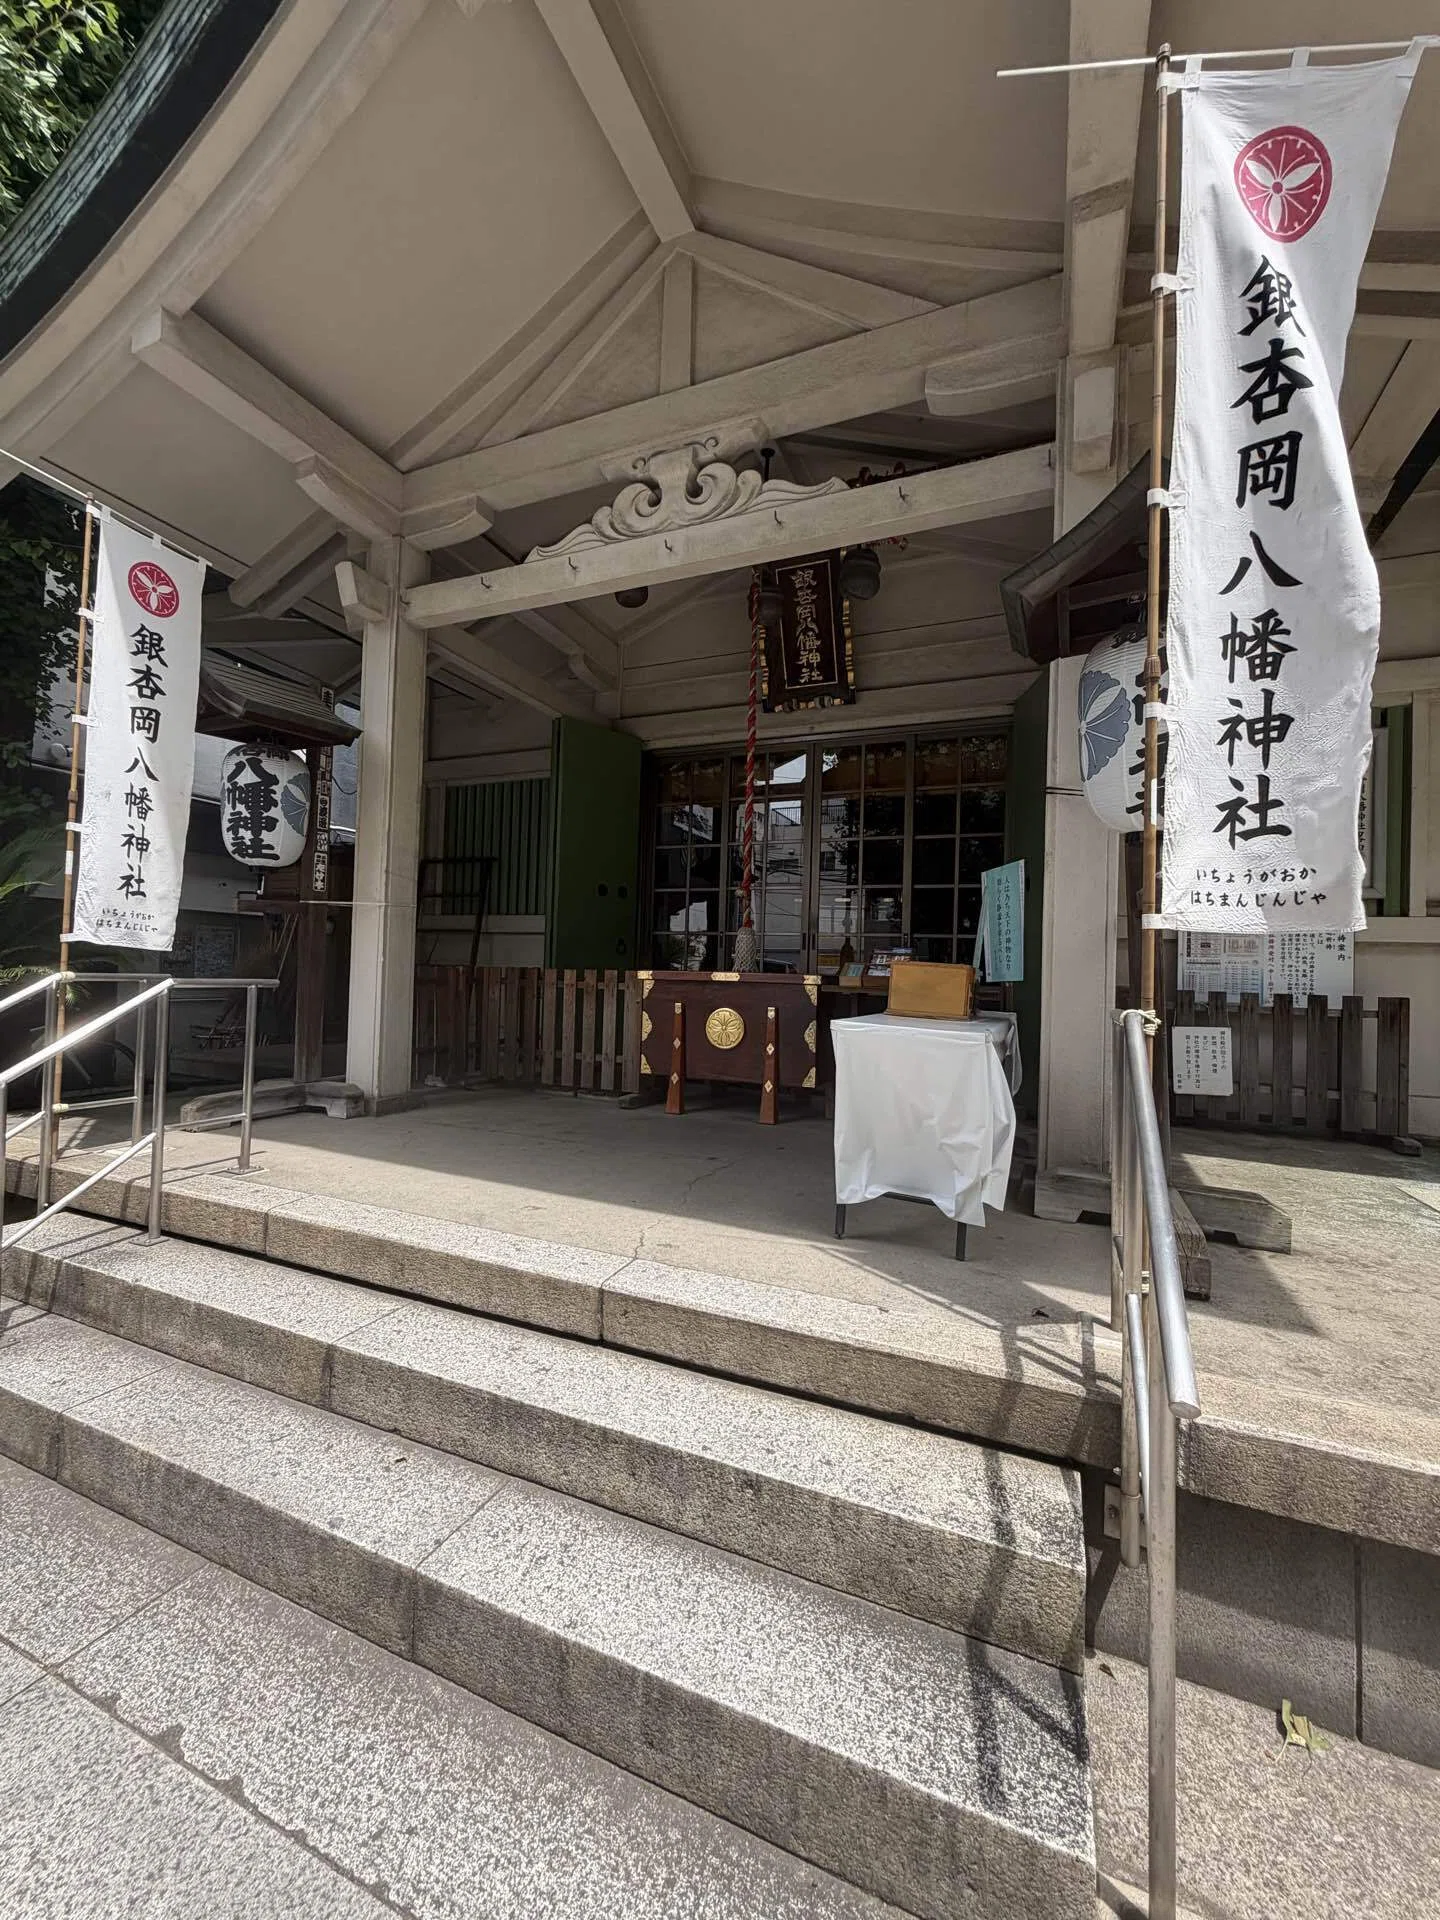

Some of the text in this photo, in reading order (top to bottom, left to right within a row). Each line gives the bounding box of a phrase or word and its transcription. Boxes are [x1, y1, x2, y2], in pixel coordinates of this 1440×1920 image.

[1212, 254, 1314, 851] 銀杏岡八幡神社
[116, 623, 168, 900] 銀杏岡八幡神社
[226, 756, 280, 861] 八幡神社
[1190, 889, 1327, 908] はちまんじんじゃ
[1196, 867, 1318, 884] いちょうがおか
[102, 907, 155, 921] いちょうがおか
